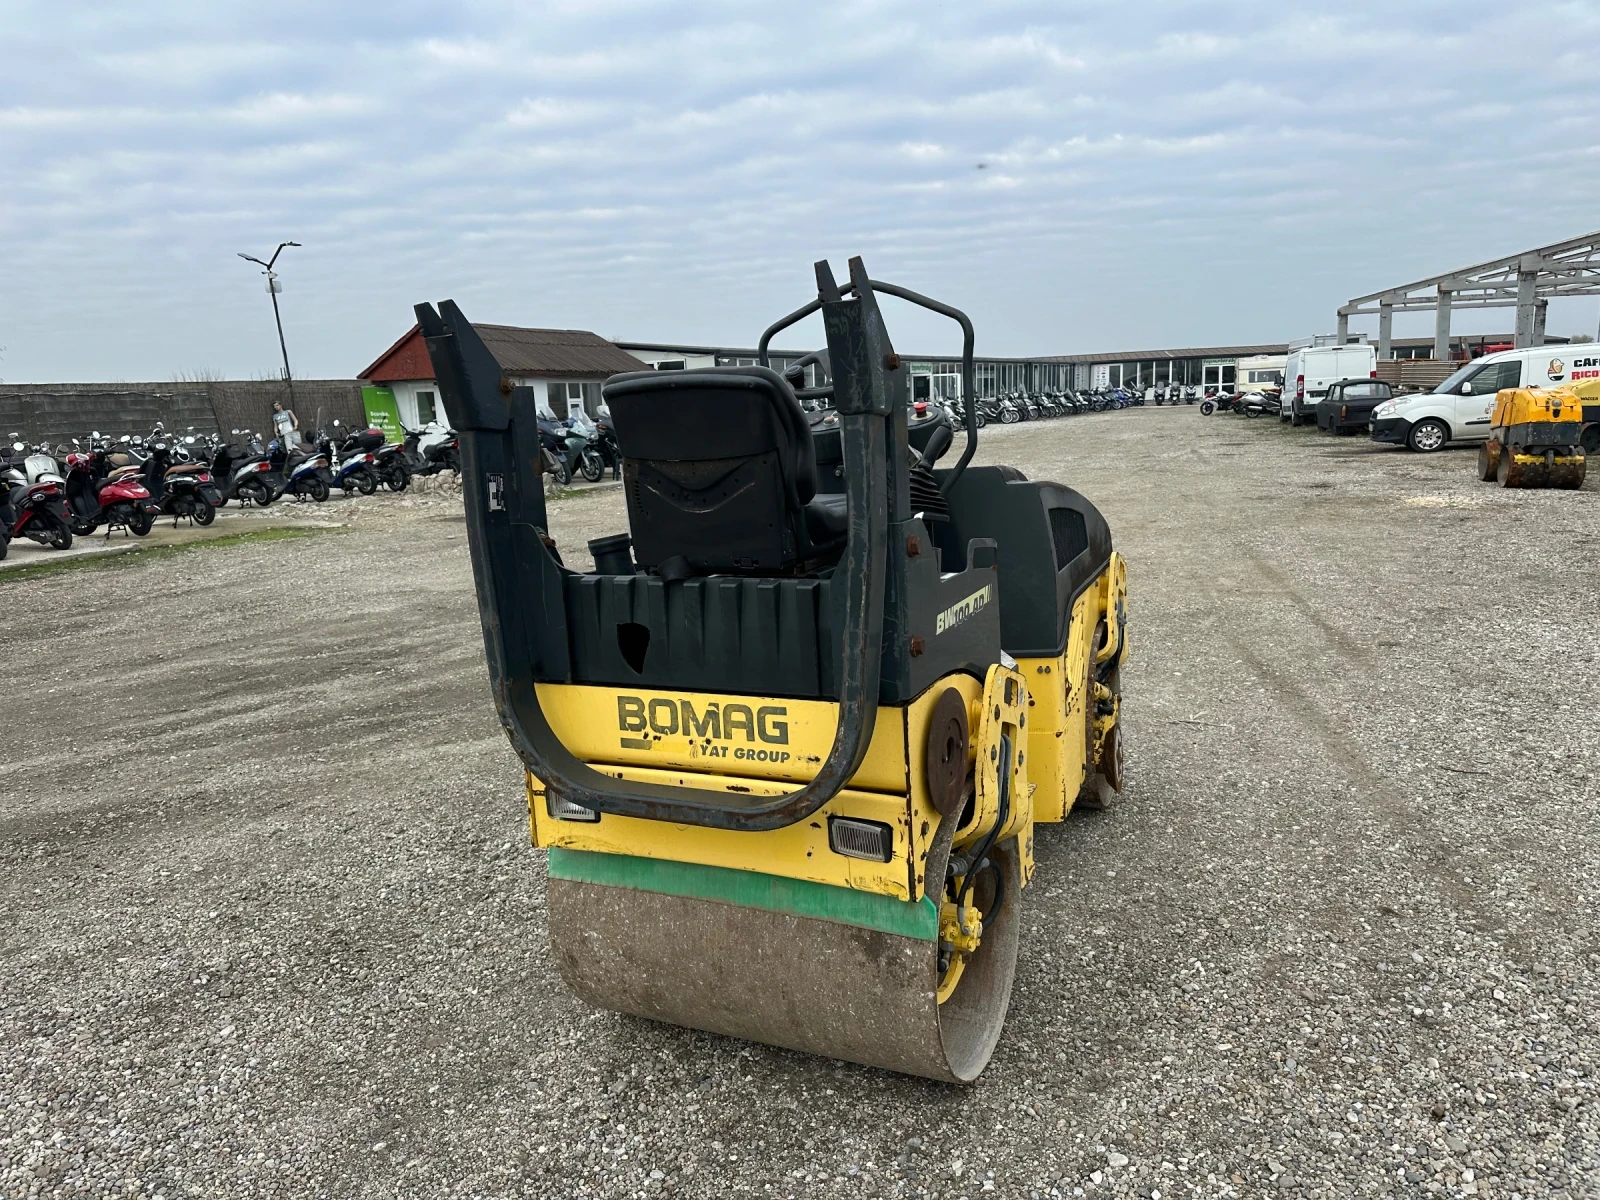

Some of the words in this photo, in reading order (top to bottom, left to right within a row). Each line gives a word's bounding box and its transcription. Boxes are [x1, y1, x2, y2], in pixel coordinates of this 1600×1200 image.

[1573, 358, 1600, 367] CAF
[617, 695, 789, 745] BOMAG
[734, 747, 791, 763] GROUP
